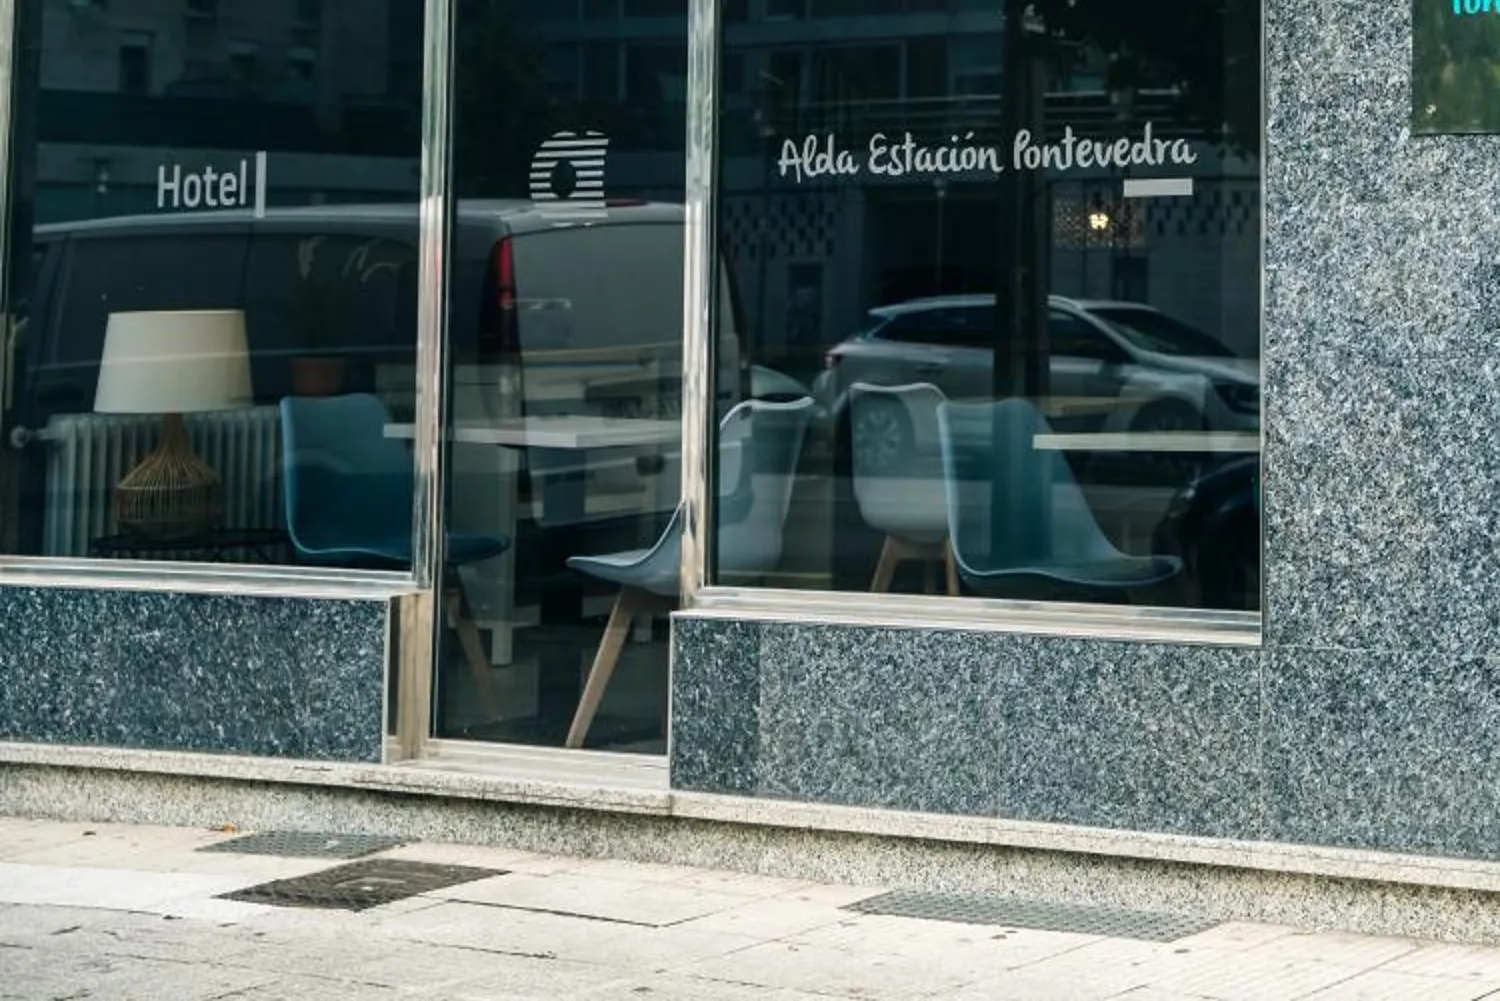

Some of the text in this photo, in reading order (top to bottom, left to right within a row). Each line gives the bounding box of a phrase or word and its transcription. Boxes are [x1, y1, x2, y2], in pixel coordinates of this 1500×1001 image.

[778, 121, 1197, 183] Alda Estación Pontevedra
[157, 159, 247, 208] Hotel
